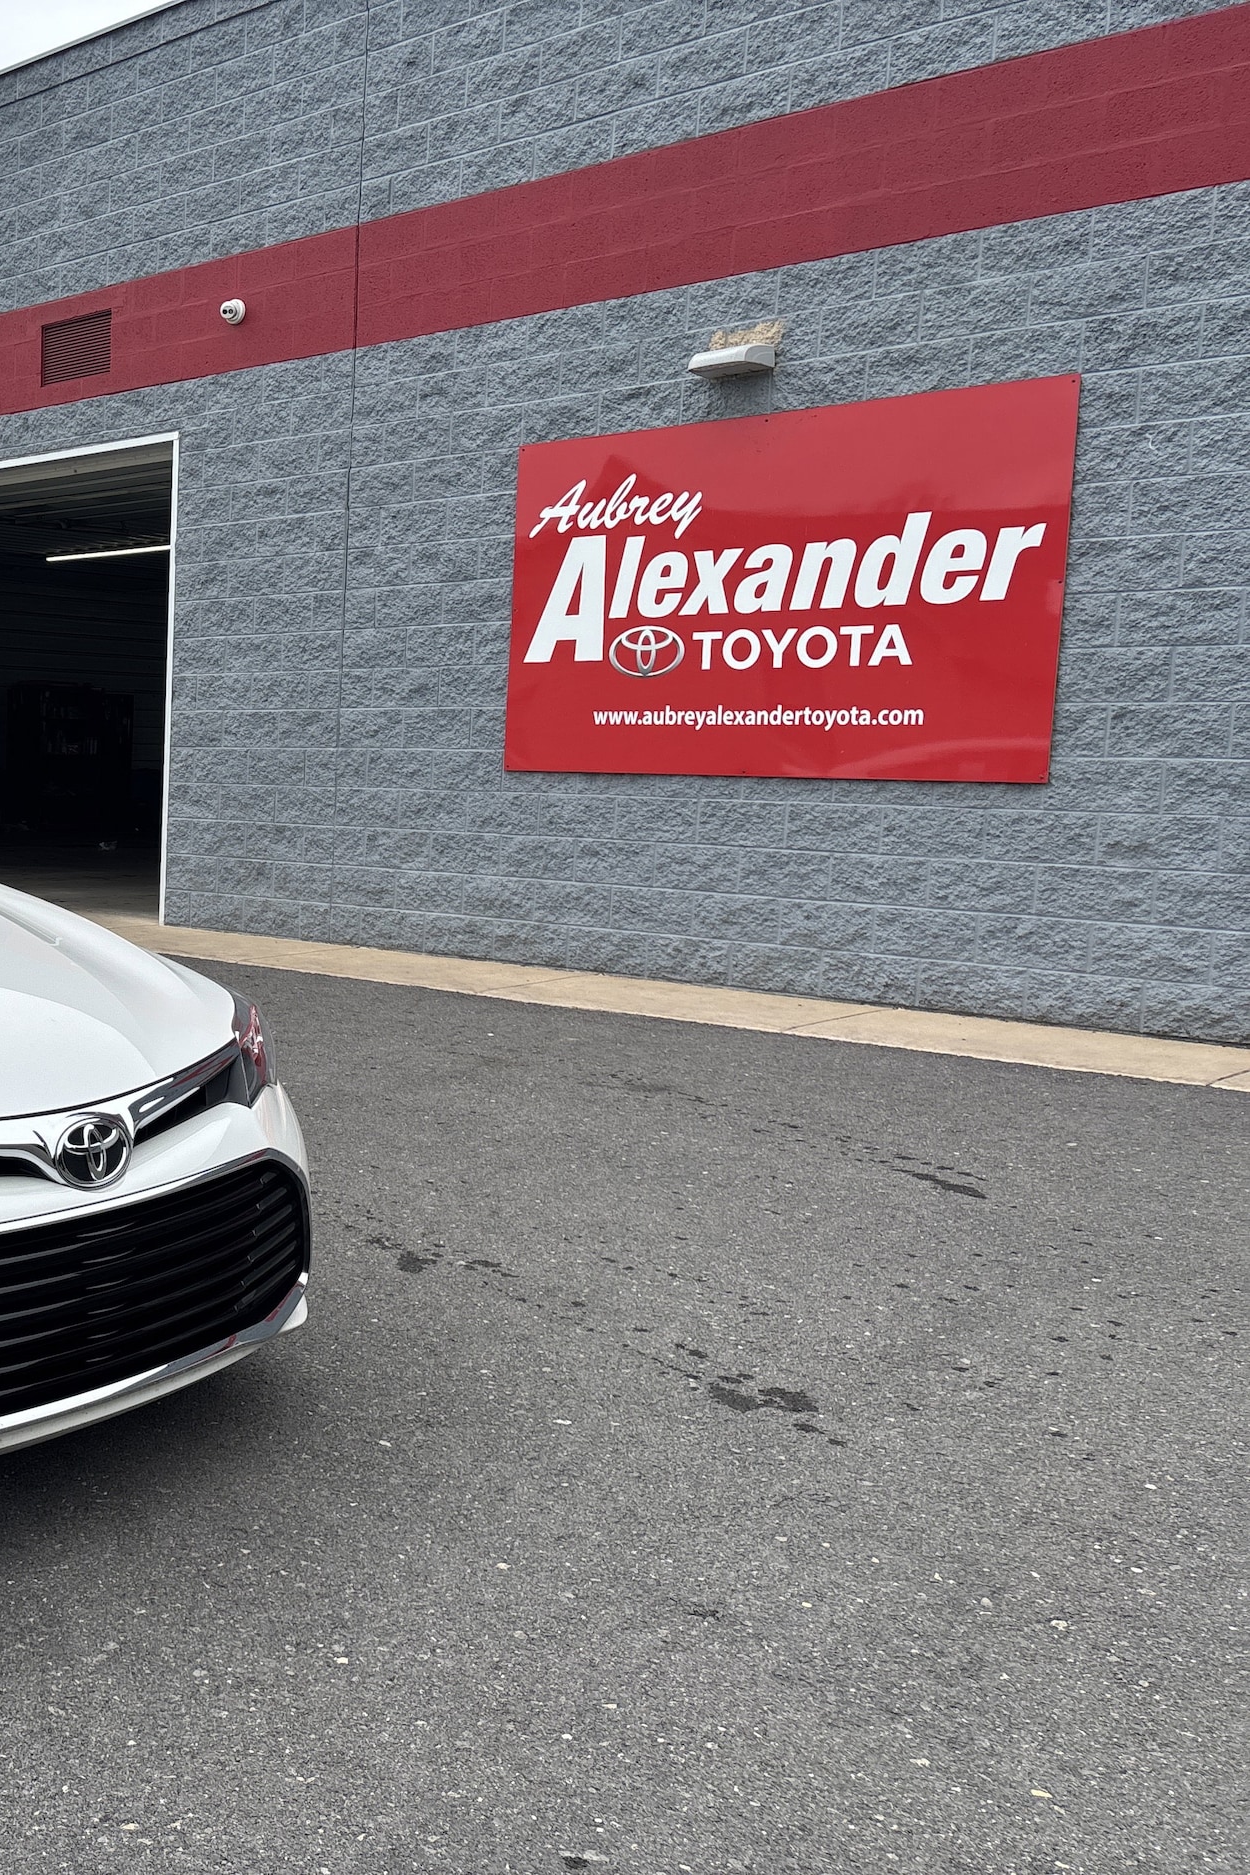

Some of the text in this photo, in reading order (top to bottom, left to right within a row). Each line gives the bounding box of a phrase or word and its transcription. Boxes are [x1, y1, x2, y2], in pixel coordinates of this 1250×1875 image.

[528, 473, 703, 539] Aubrey
[523, 511, 1048, 664] Alexander
[692, 623, 913, 670] TOYOTA
[593, 704, 925, 732] www.aubreyalexandertoyota.com
